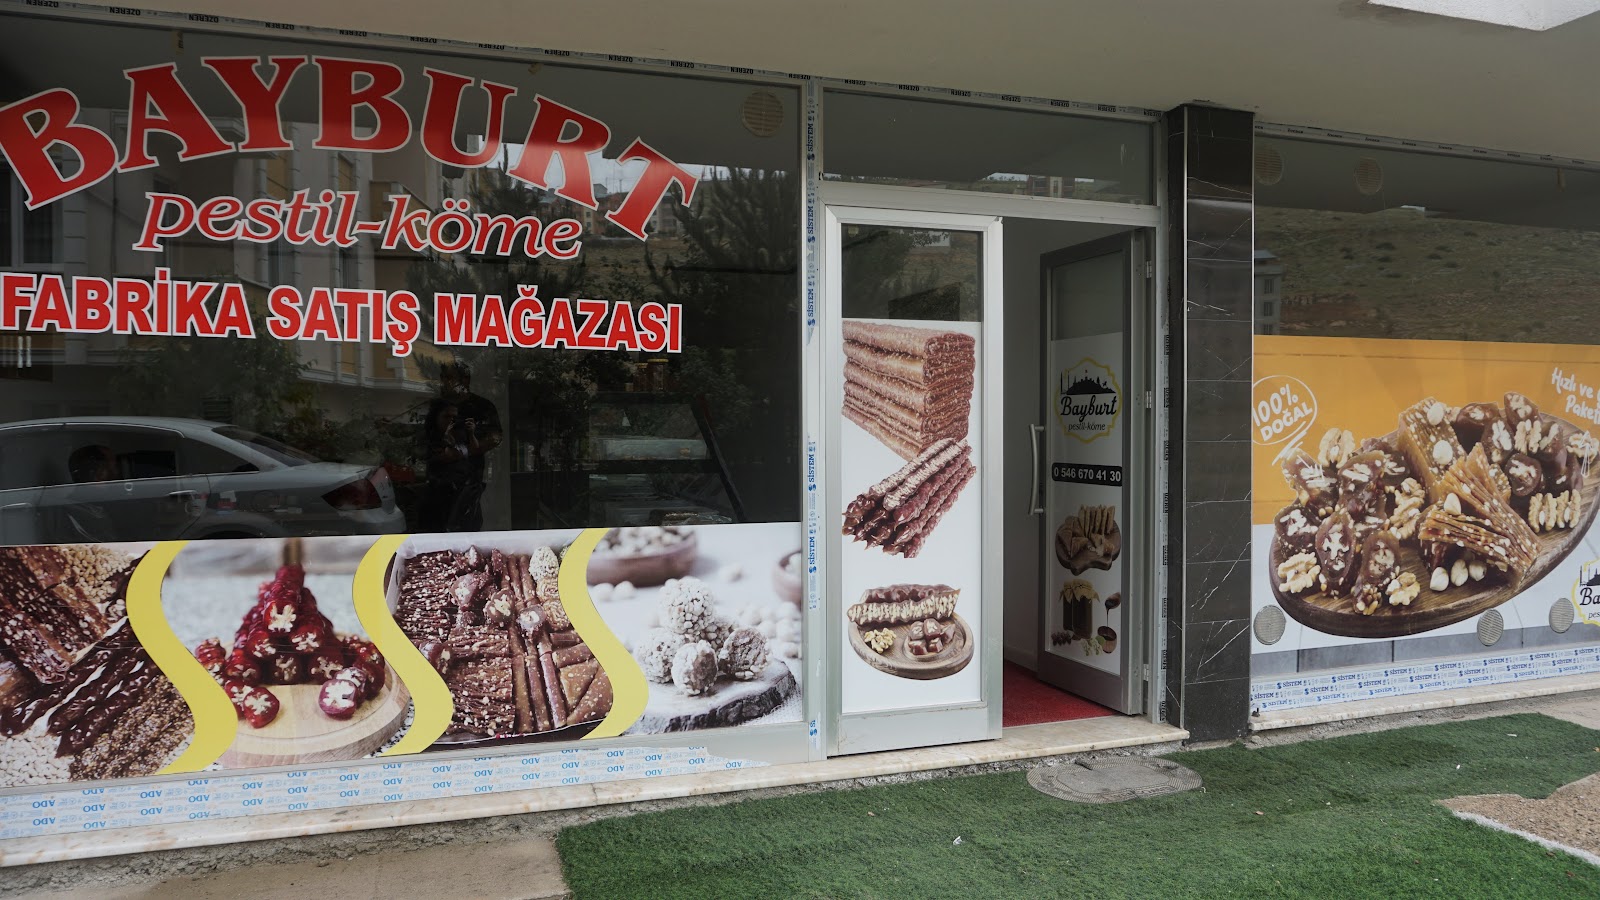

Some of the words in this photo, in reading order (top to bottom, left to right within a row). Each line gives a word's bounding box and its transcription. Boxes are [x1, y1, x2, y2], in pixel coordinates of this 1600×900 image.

[0, 55, 699, 242] BAYBURT
[132, 187, 583, 259] pestil-köme
[0, 267, 256, 339] FABRİKA
[266, 284, 420, 357] SATIŞ
[433, 284, 682, 353] MAĞAZASI
[1060, 394, 1117, 422] Bayburt
[1252, 384, 1298, 427] 100%
[1579, 383, 1593, 398] ve
[1068, 421, 1106, 432] pestil-köme
[1260, 402, 1313, 442] DOĞAL
[1054, 468, 1059, 477] 0
[1061, 468, 1076, 479] 546
[1078, 469, 1094, 480] 670
[1096, 470, 1107, 481] 41
[1110, 471, 1121, 482] 30
